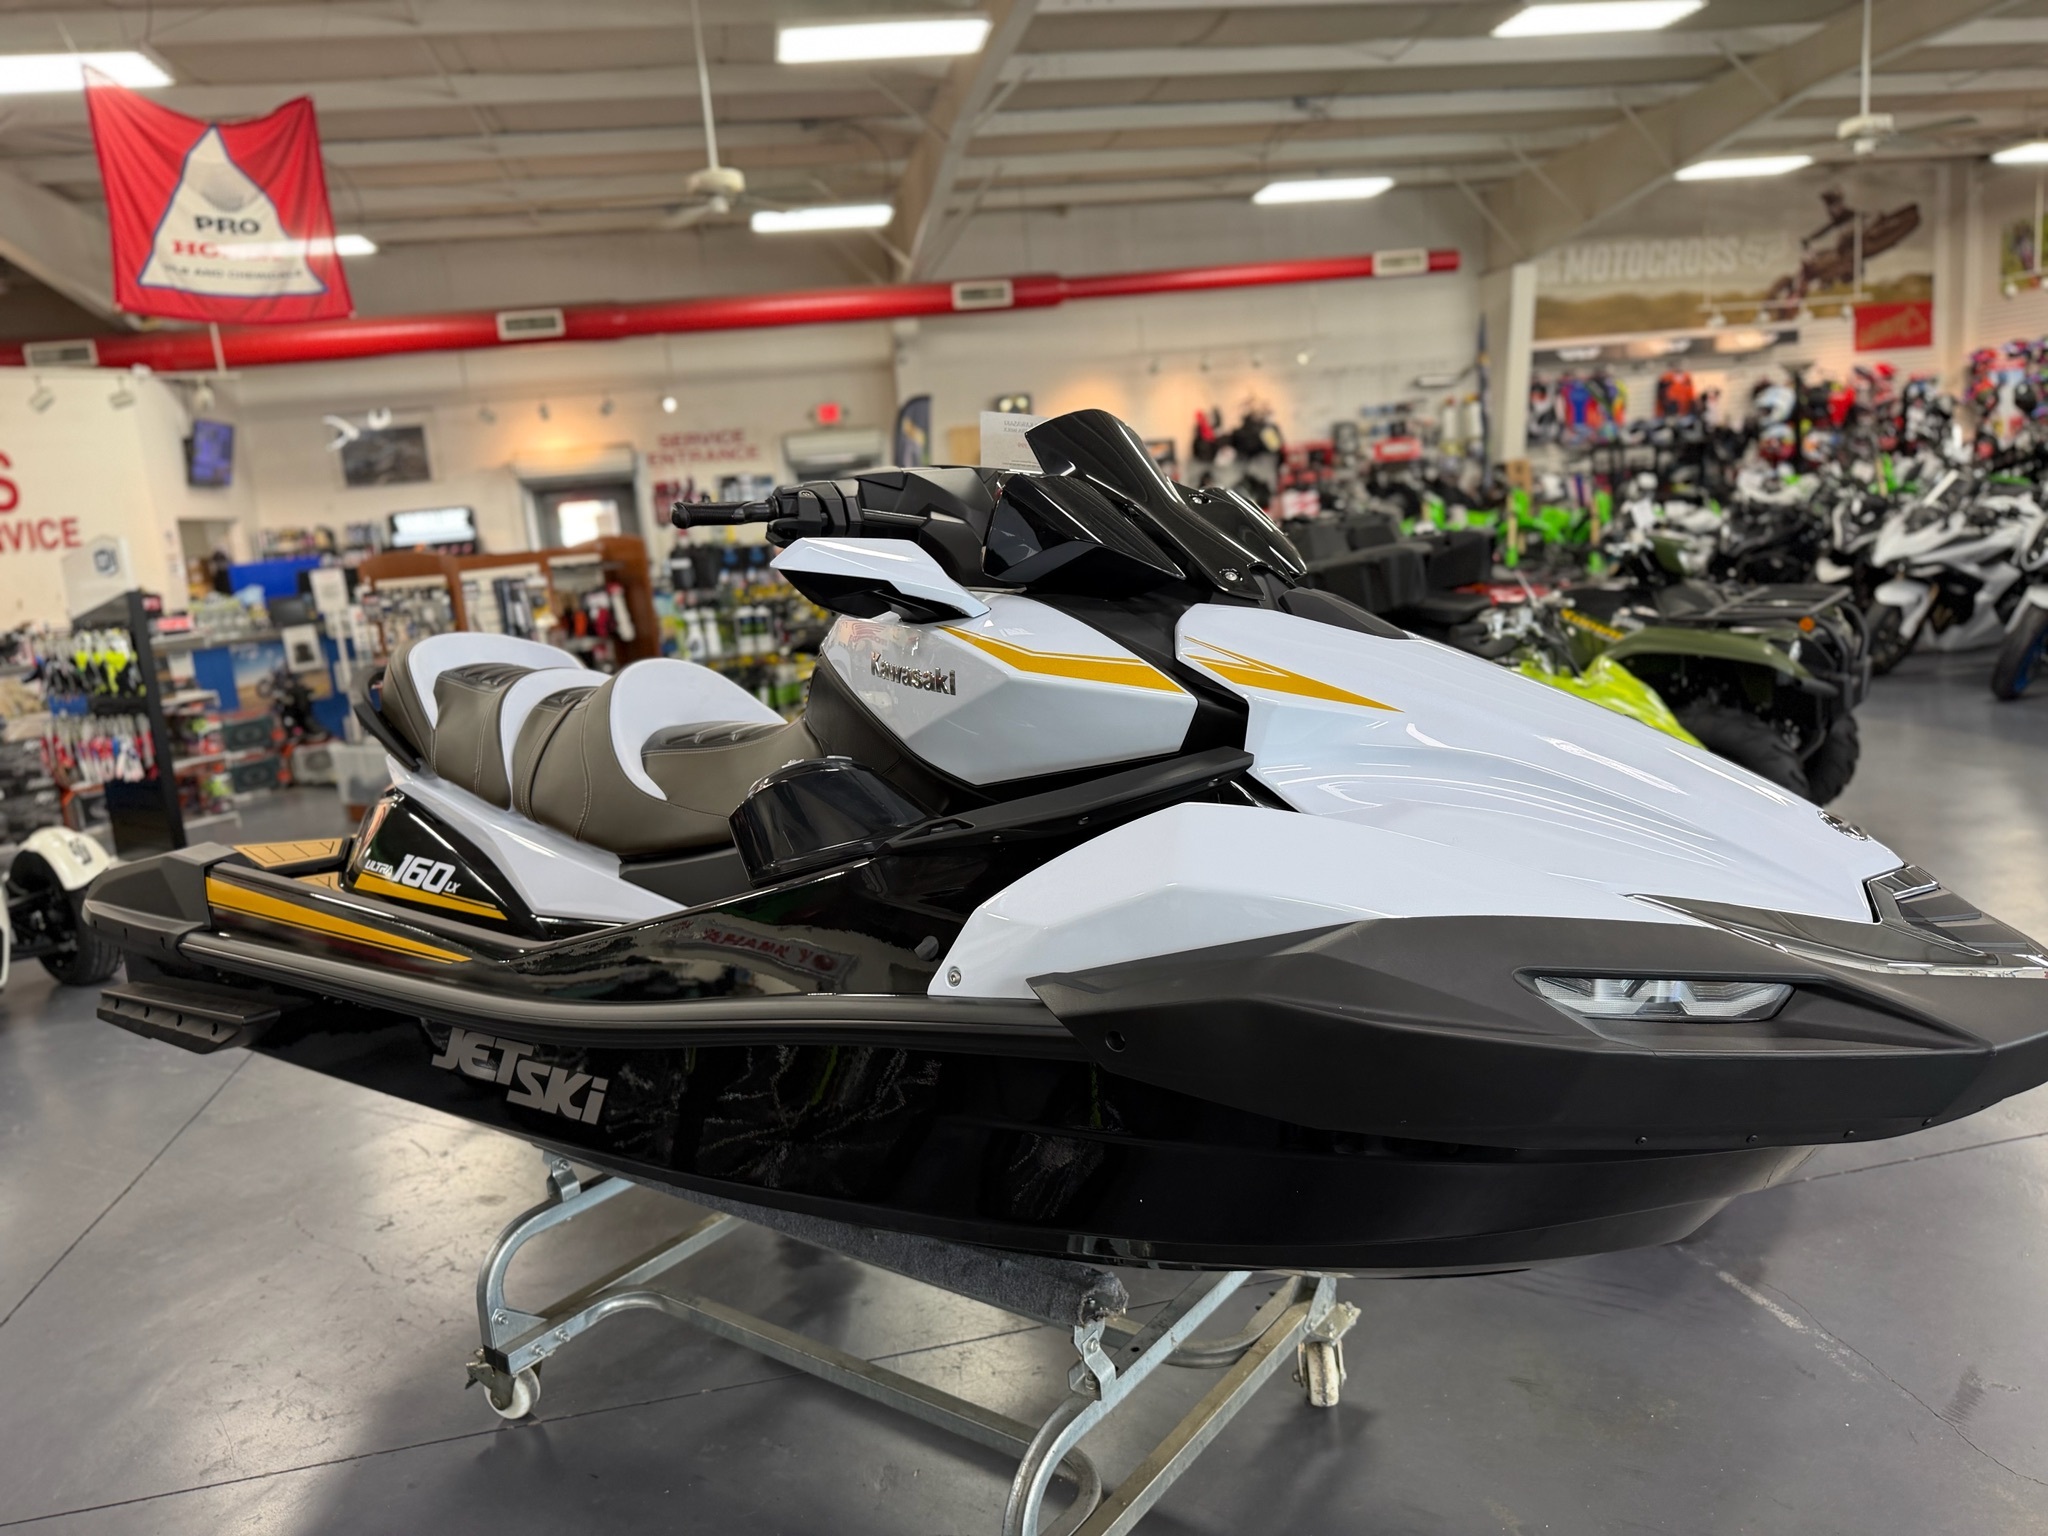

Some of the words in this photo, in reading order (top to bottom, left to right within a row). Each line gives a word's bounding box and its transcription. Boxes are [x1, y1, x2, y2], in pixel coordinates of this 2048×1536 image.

[195, 216, 260, 235] PRO
[1564, 235, 1740, 285] MOTOCROSS
[647, 446, 759, 466] ENTRANCE
[658, 429, 744, 448] SERVICE
[0, 517, 83, 554] VICE
[870, 651, 957, 696] Kawasaki
[365, 859, 394, 876] ULTRA
[393, 854, 456, 894] 160
